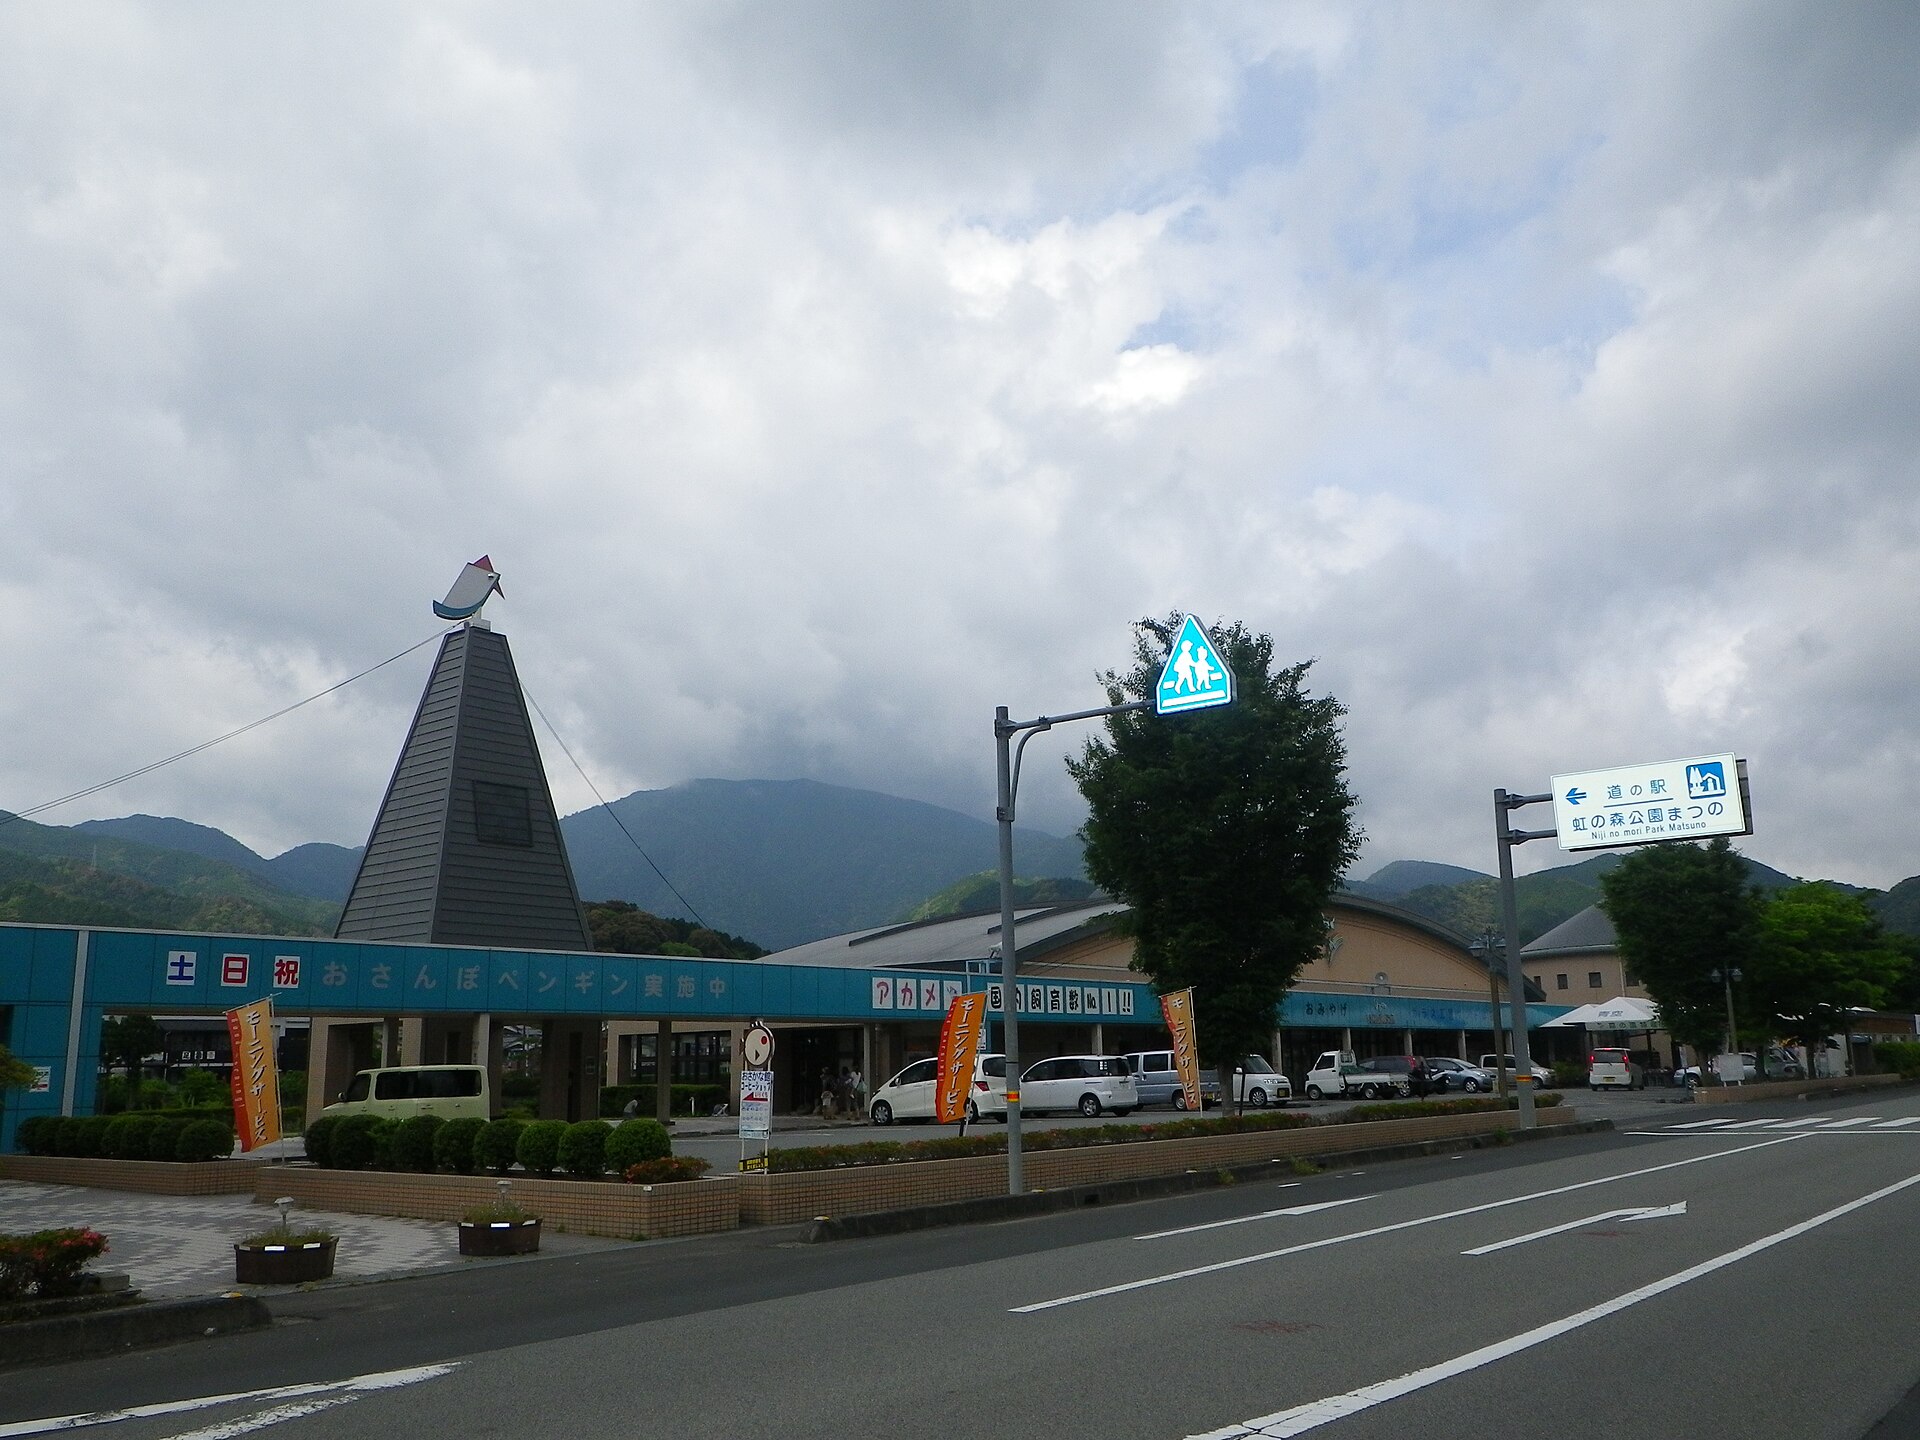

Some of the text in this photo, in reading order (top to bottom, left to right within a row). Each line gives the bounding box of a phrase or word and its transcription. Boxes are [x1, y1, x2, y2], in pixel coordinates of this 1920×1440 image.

[1606, 778, 1668, 800] 道の駅
[1572, 801, 1724, 832] 虹の森公園まつの
[1591, 820, 1707, 841] Niji no mori Park Matsuno
[945, 998, 976, 1118] モーニングサービス
[246, 1010, 268, 1141] モーニングサービス
